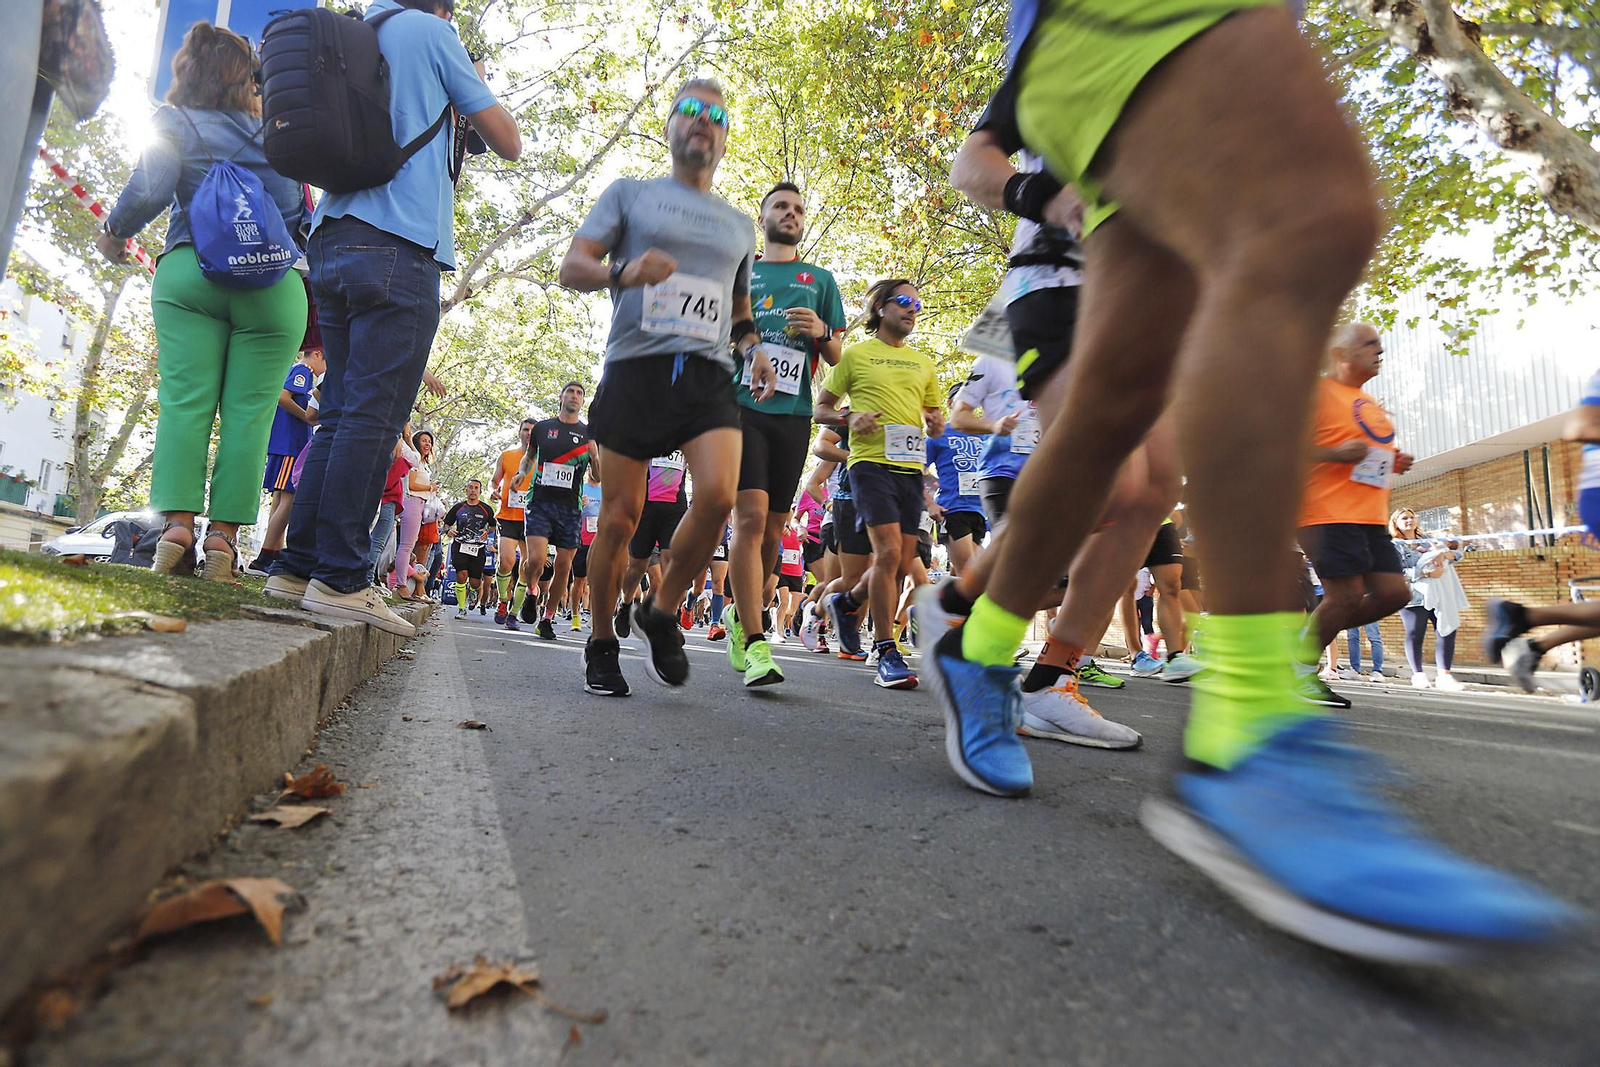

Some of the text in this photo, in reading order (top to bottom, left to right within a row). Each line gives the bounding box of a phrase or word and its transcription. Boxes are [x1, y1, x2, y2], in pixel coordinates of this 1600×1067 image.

[679, 290, 719, 323] 745
[769, 357, 800, 382] 394
[555, 470, 572, 482] 190
